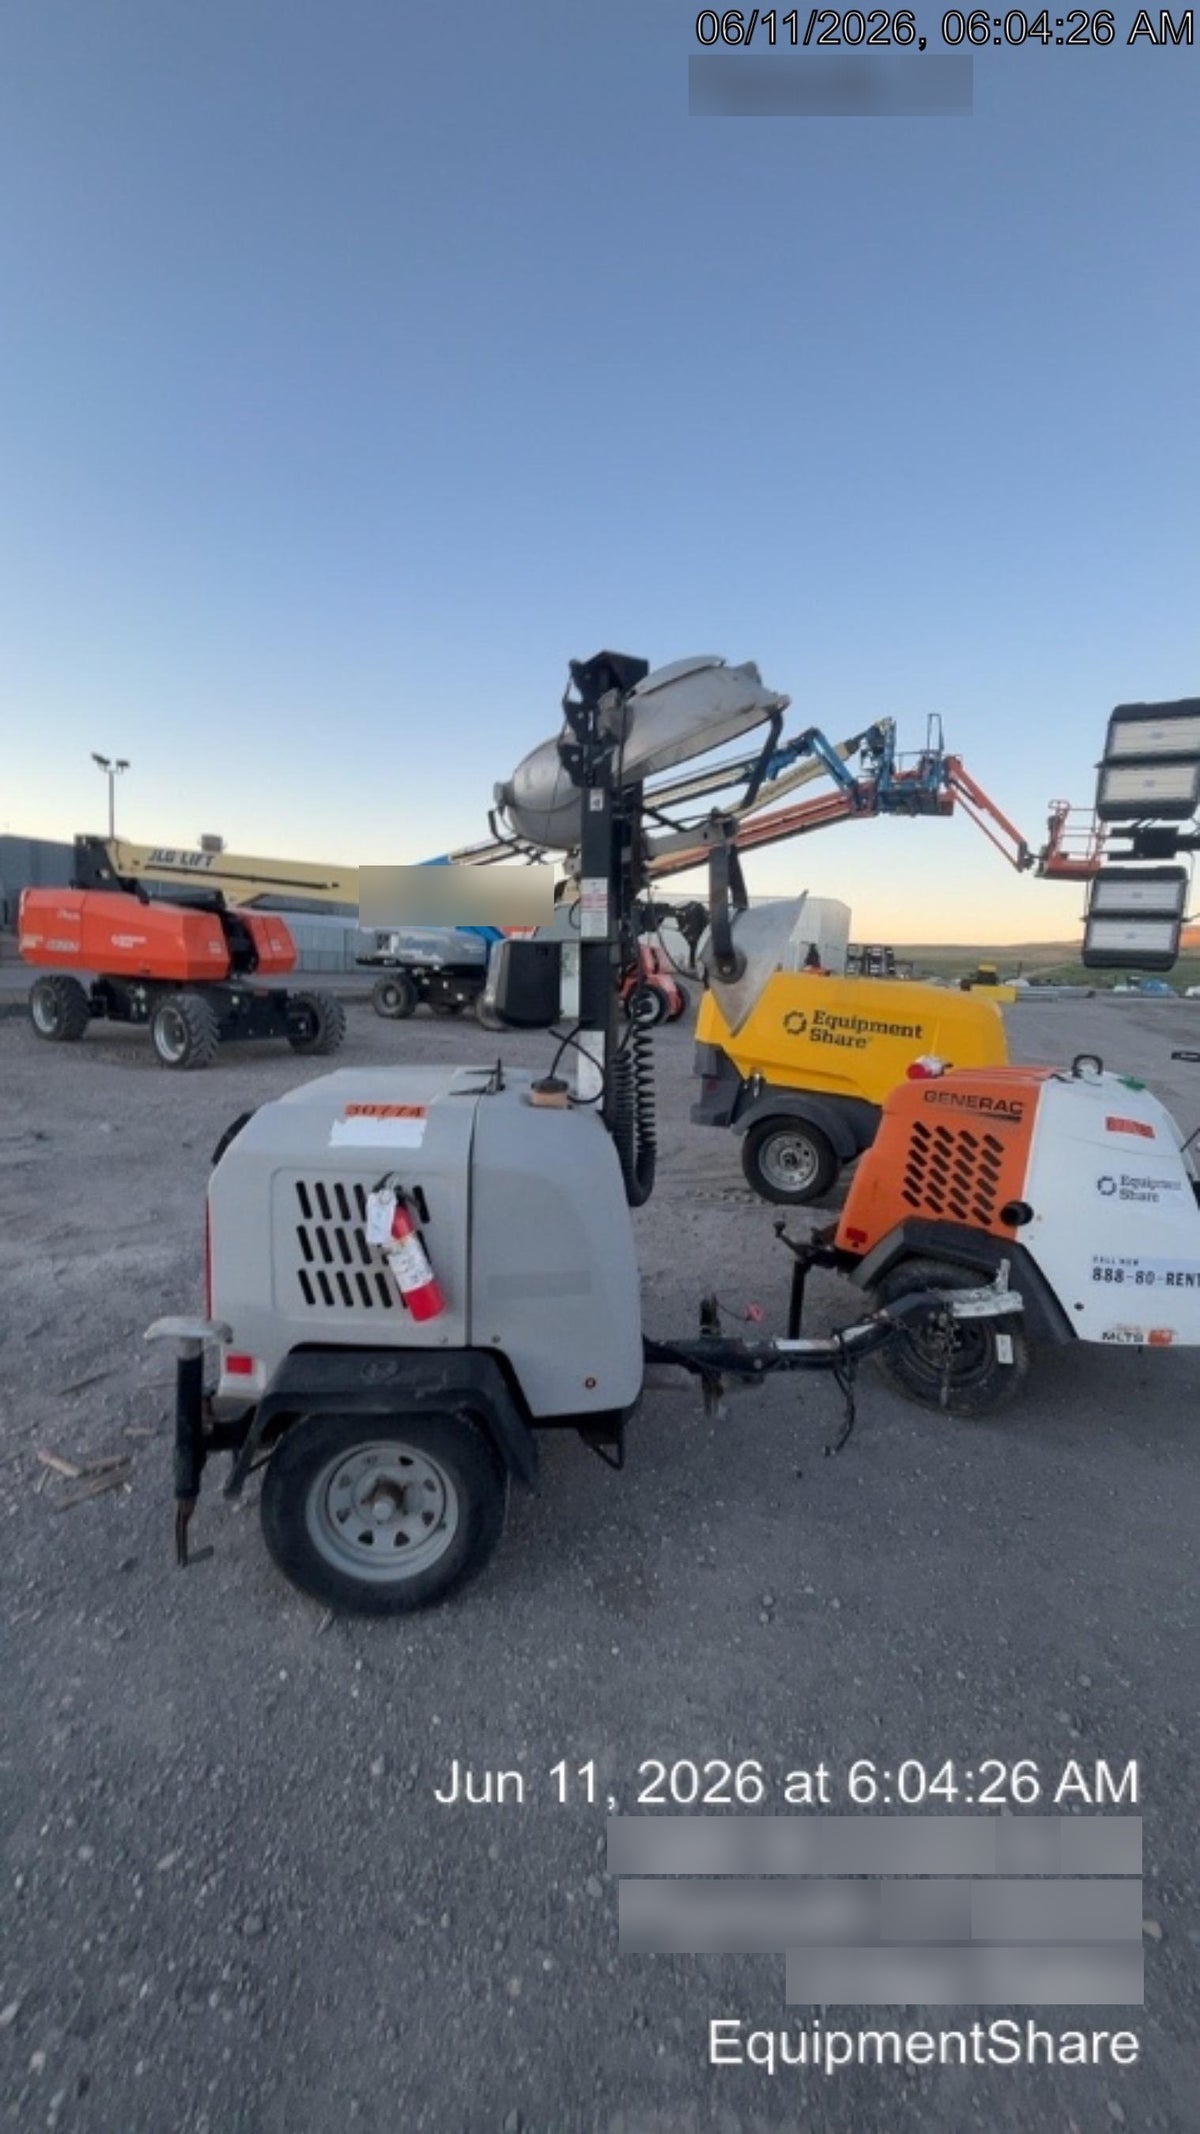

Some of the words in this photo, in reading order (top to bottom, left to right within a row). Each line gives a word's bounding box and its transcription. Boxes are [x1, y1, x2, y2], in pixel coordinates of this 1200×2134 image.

[148, 848, 176, 865] JLG
[180, 850, 216, 869] LIFT
[813, 1010, 923, 1039] Equipment
[810, 1028, 867, 1048] Share
[924, 1089, 1023, 1115] GENERAC
